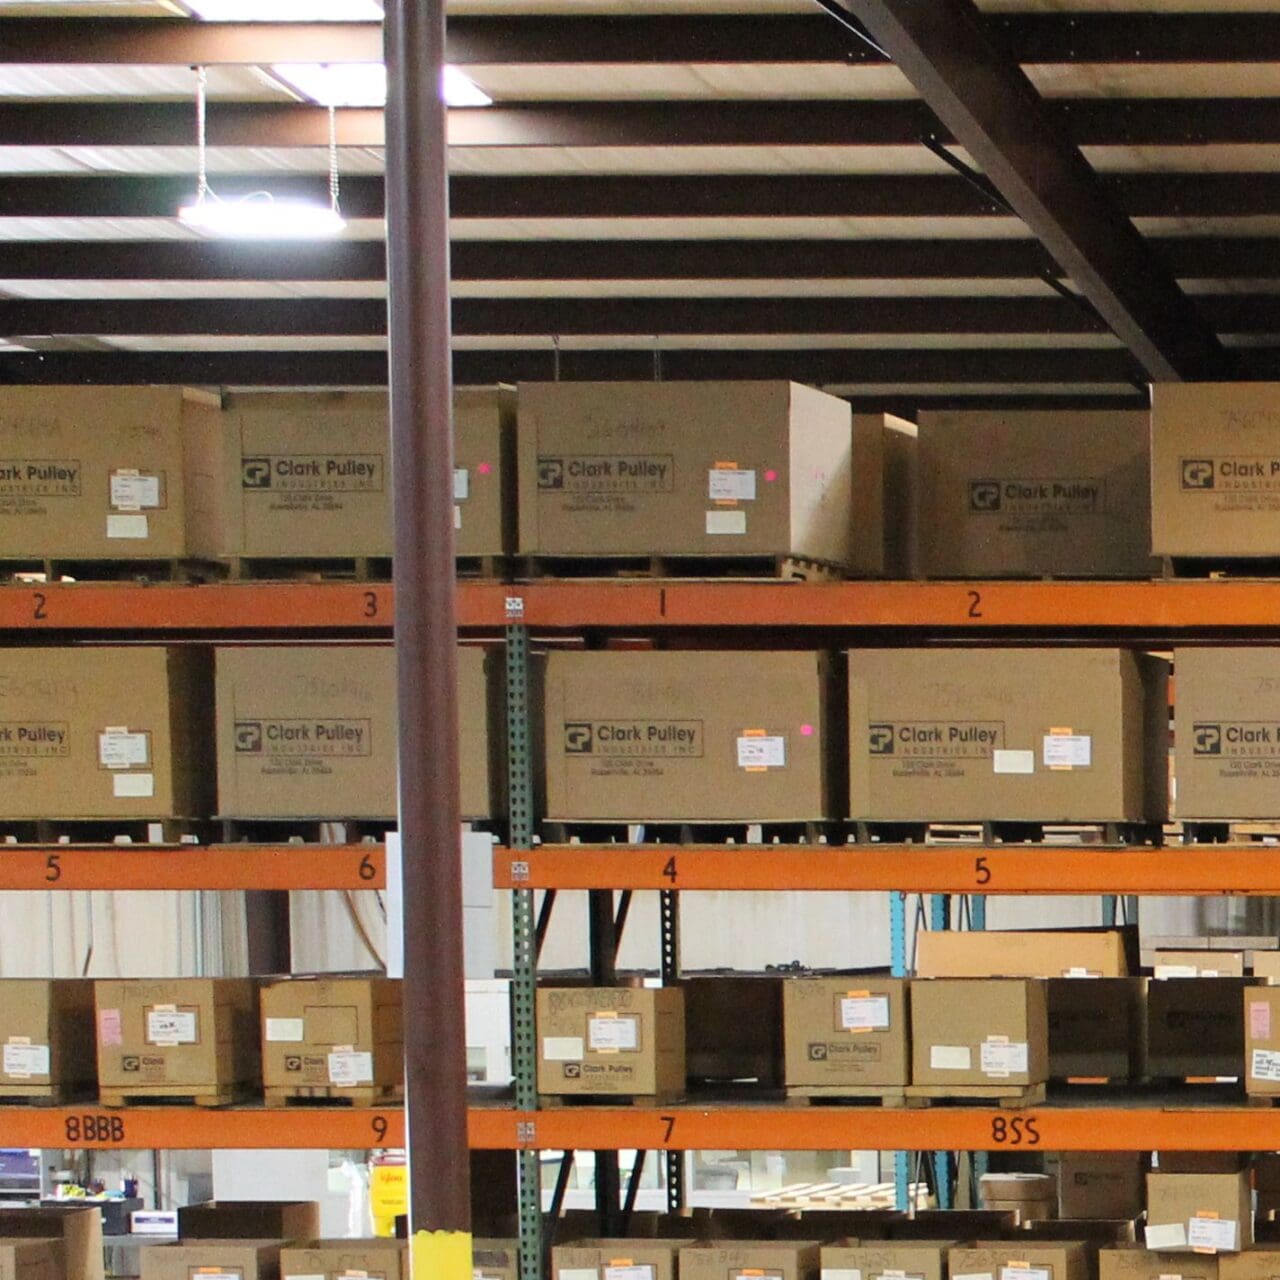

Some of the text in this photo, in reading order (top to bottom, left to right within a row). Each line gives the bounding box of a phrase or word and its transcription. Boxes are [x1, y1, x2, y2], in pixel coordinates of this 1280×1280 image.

[26, 465, 78, 483] Pulley
[276, 459, 376, 478] Clark Pulley
[569, 460, 667, 479] Clark Pulley
[1219, 461, 1264, 476] Clark
[33, 592, 47, 620] 2
[363, 591, 378, 618] 3
[659, 588, 666, 617] 1
[967, 590, 983, 618] 2
[17, 726, 66, 744] Pulley
[267, 724, 364, 743] Clark Pulley
[598, 725, 696, 744] Clark Pulley
[900, 726, 996, 745] Clark Pulley
[1226, 726, 1271, 743] Clark
[45, 854, 61, 882] 5
[358, 854, 377, 881] 6
[662, 855, 678, 884] 4
[975, 857, 991, 885] 5
[371, 1115, 388, 1143] 9
[660, 1116, 676, 1143] 7
